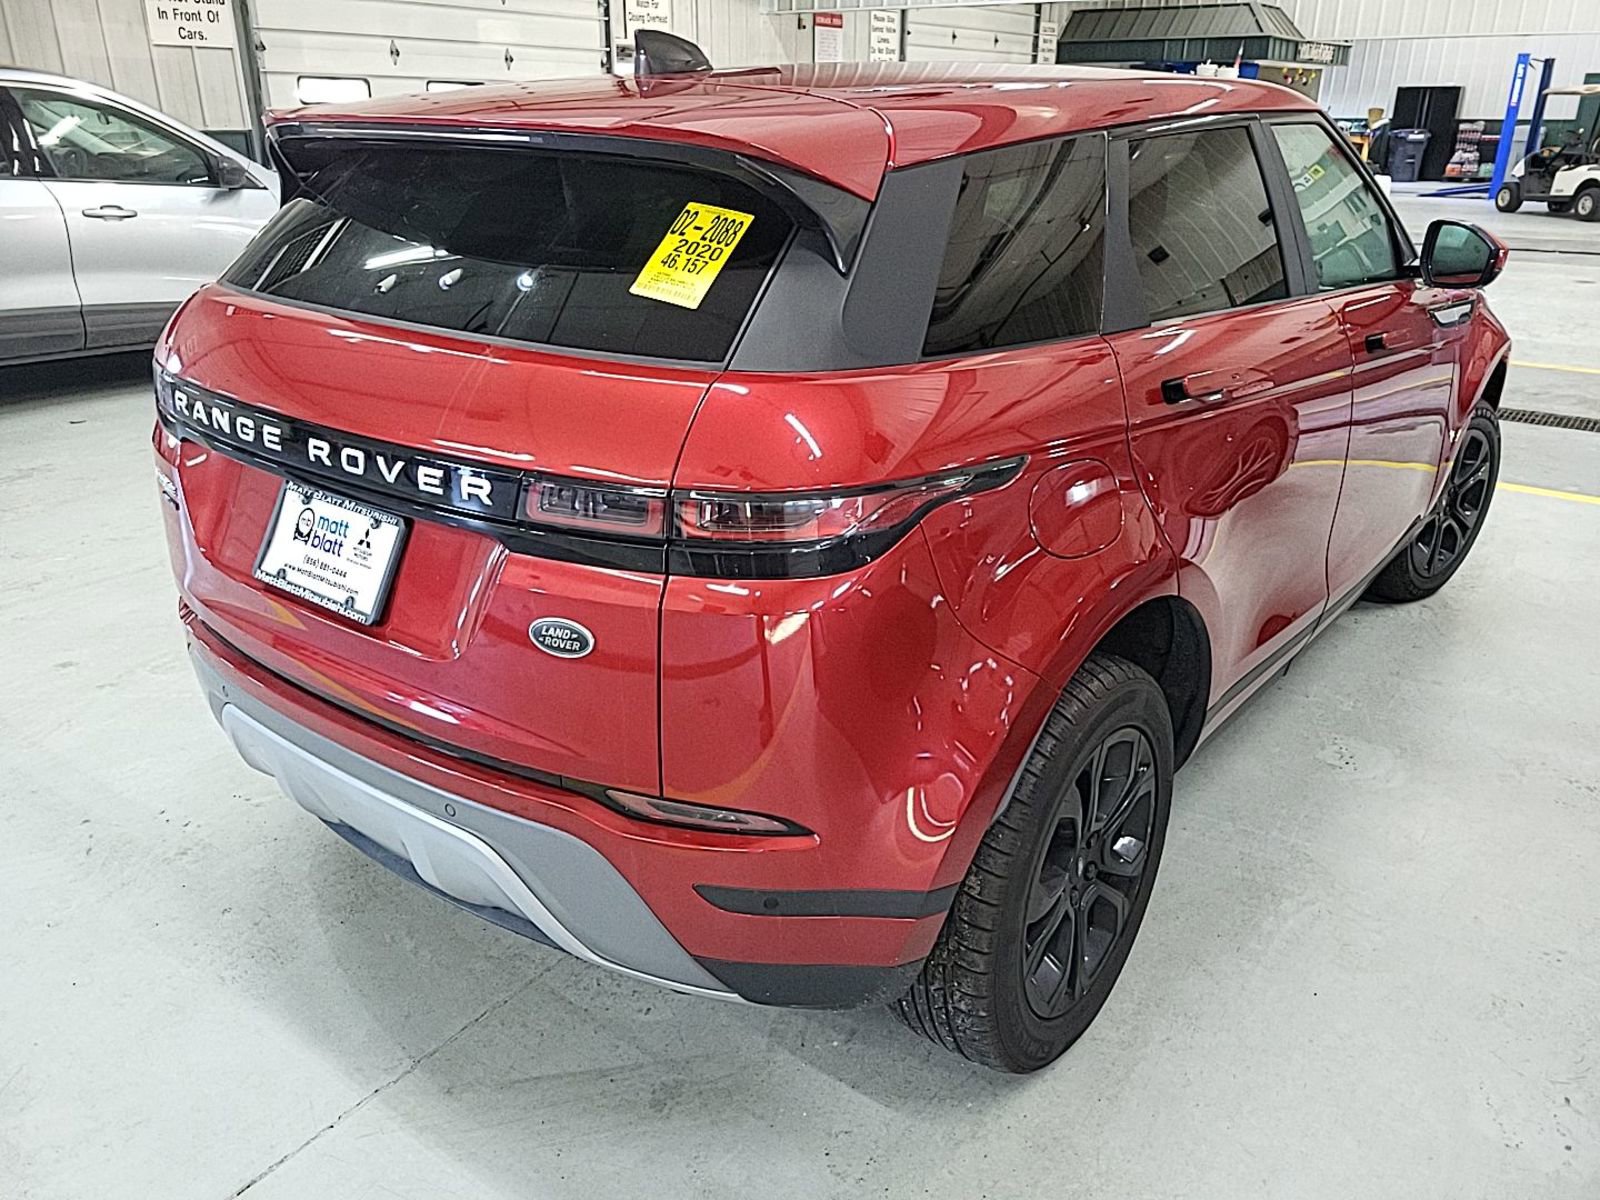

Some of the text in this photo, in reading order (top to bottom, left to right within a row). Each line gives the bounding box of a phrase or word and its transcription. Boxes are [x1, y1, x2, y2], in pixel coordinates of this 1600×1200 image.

[157, 7, 220, 24] In Front Of
[178, 26, 208, 41] Cars.
[672, 238, 724, 262] 2020
[174, 389, 493, 505] RANGE ROVER
[316, 515, 350, 539] matt
[310, 530, 344, 558] blatt
[541, 625, 571, 640] LAND
[544, 636, 581, 651] ROVER
